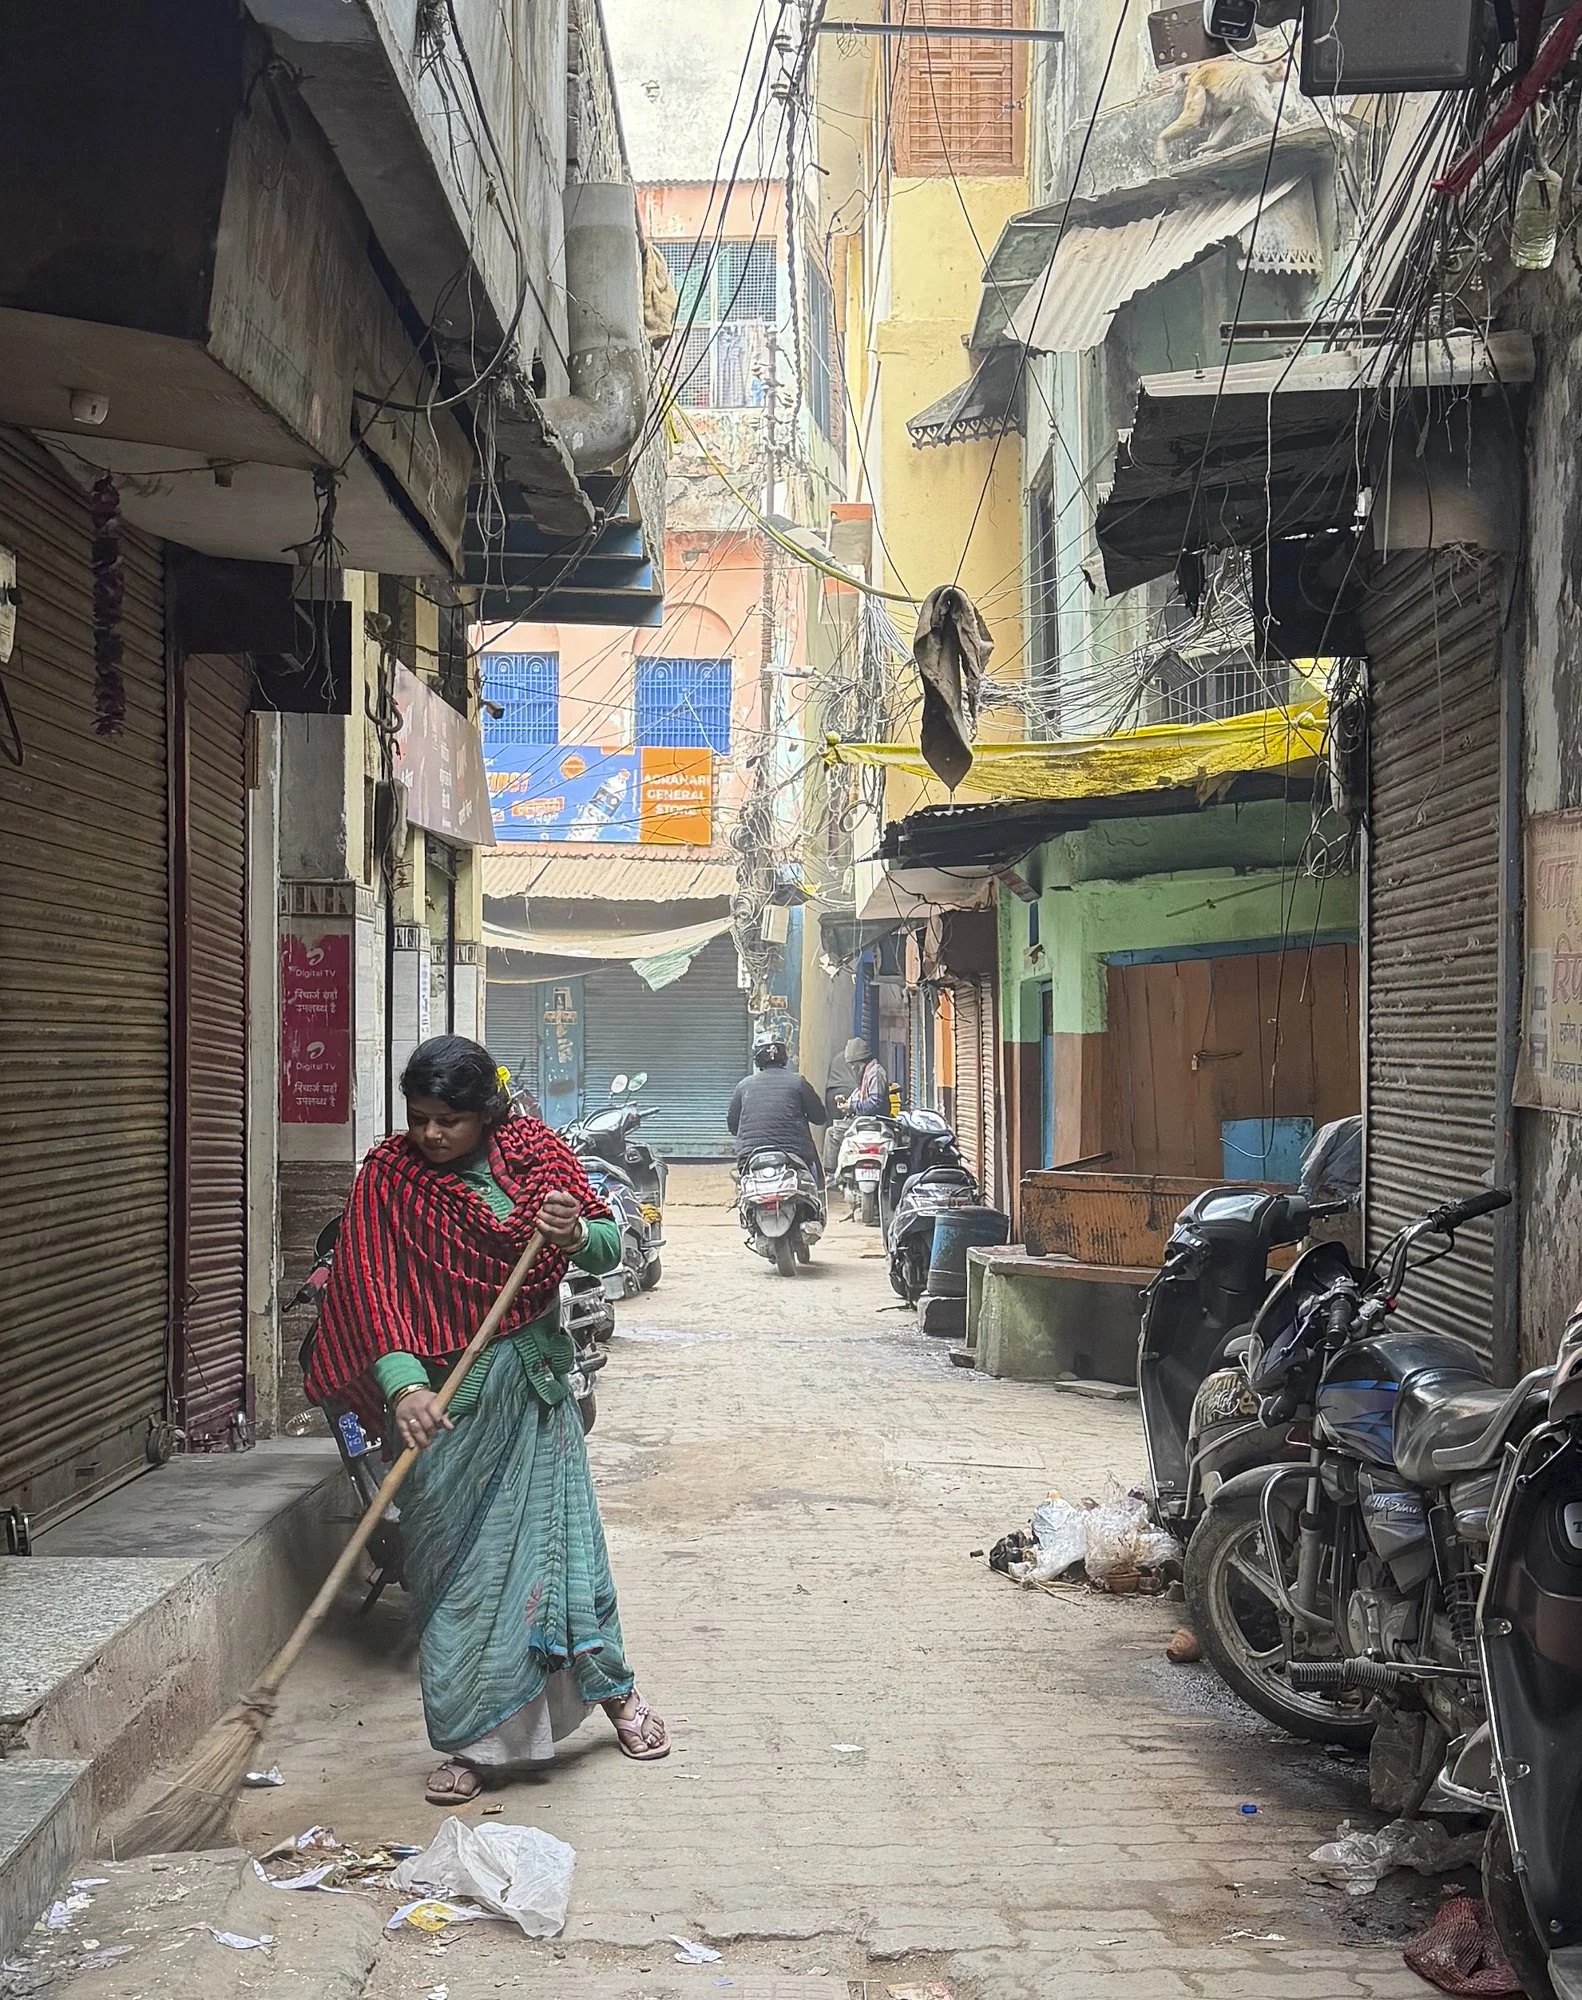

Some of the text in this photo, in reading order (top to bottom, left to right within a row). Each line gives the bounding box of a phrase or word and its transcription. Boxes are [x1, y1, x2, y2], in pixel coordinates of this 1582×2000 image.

[646, 788, 706, 801] GENERAL
[655, 803, 697, 816] STORE
[295, 969, 336, 978] Digital TV
[296, 1062, 336, 1071] Digital TV
